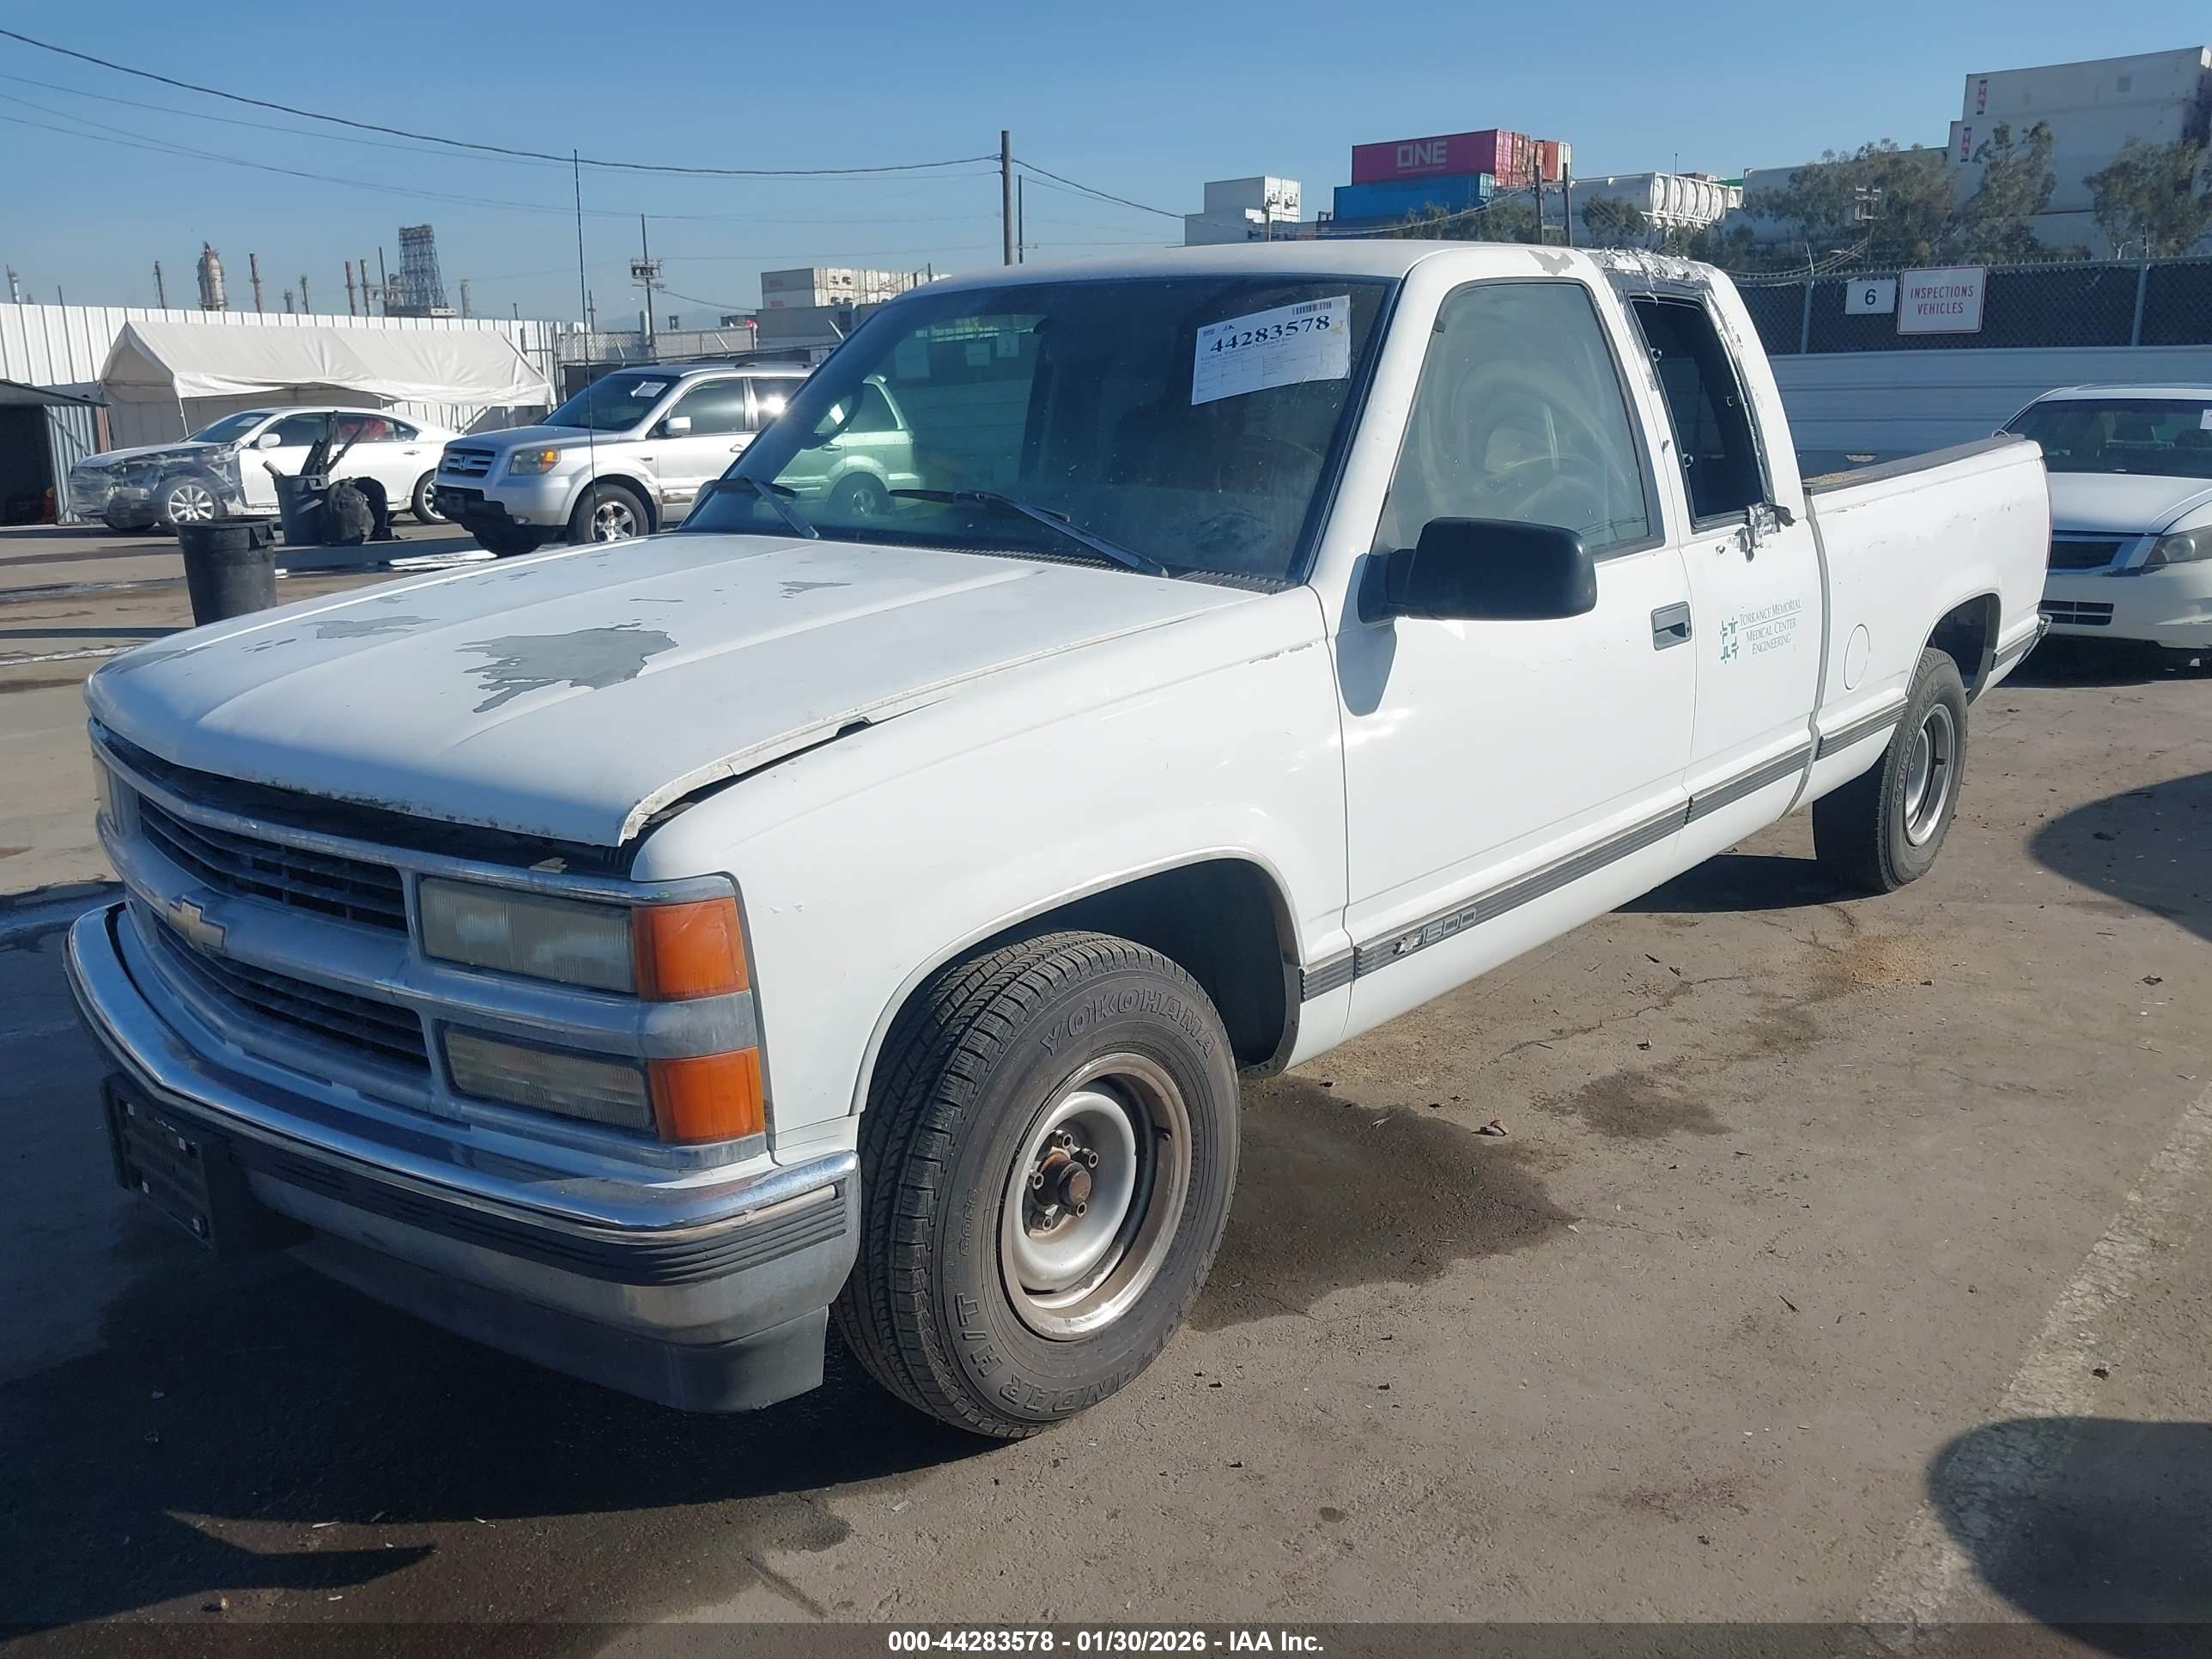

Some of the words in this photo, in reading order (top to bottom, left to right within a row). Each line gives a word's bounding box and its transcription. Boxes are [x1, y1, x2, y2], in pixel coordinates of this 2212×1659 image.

[1396, 141, 1447, 167] ONE
[1864, 289, 1876, 306] 6
[1911, 285, 1974, 300] INSPECTIONS
[1917, 301, 1964, 315] VEHICLES
[1209, 315, 1330, 353] 44283578
[1739, 607, 1771, 626] TORRANCE
[1772, 598, 1802, 616] MEMORIAL
[1746, 625, 1773, 643] MEDICAL
[1774, 617, 1796, 634] CENTER
[1752, 633, 1791, 656] ENGINEERING
[1040, 987, 1217, 1060] YOKOHAMA
